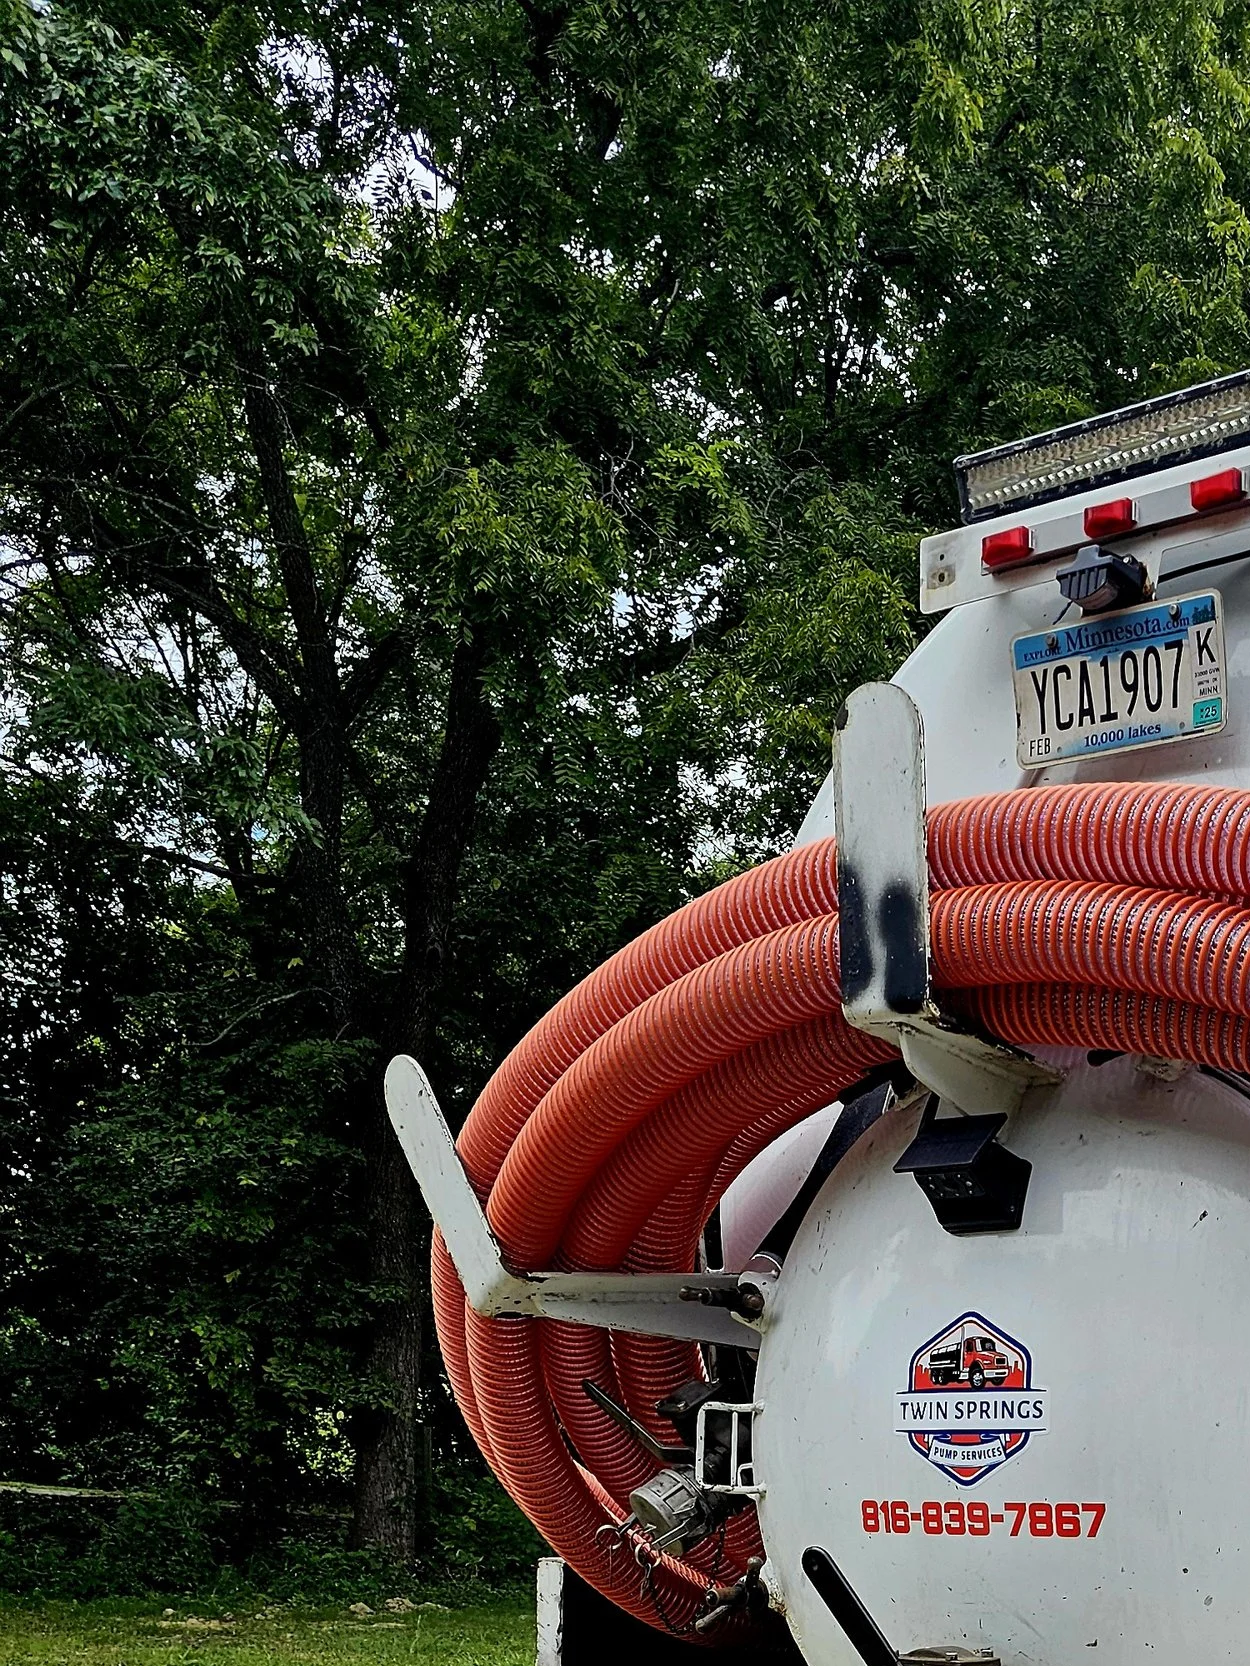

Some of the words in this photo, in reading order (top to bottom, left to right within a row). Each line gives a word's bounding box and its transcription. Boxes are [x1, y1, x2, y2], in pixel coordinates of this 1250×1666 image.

[1196, 627, 1217, 666] K
[1031, 639, 1184, 735] YCA1907
[1199, 686, 1218, 696] MINN
[1205, 705, 1217, 719] 25
[1084, 729, 1124, 747] 10,000
[1128, 723, 1161, 739] lakes
[1030, 737, 1051, 757] FEB
[900, 1401, 948, 1420] TWIN
[954, 1400, 1044, 1420] SPRINGS
[933, 1447, 958, 1461] PUMP
[961, 1447, 1002, 1461] SERVICES
[861, 1500, 1106, 1538] 816-839-7867
